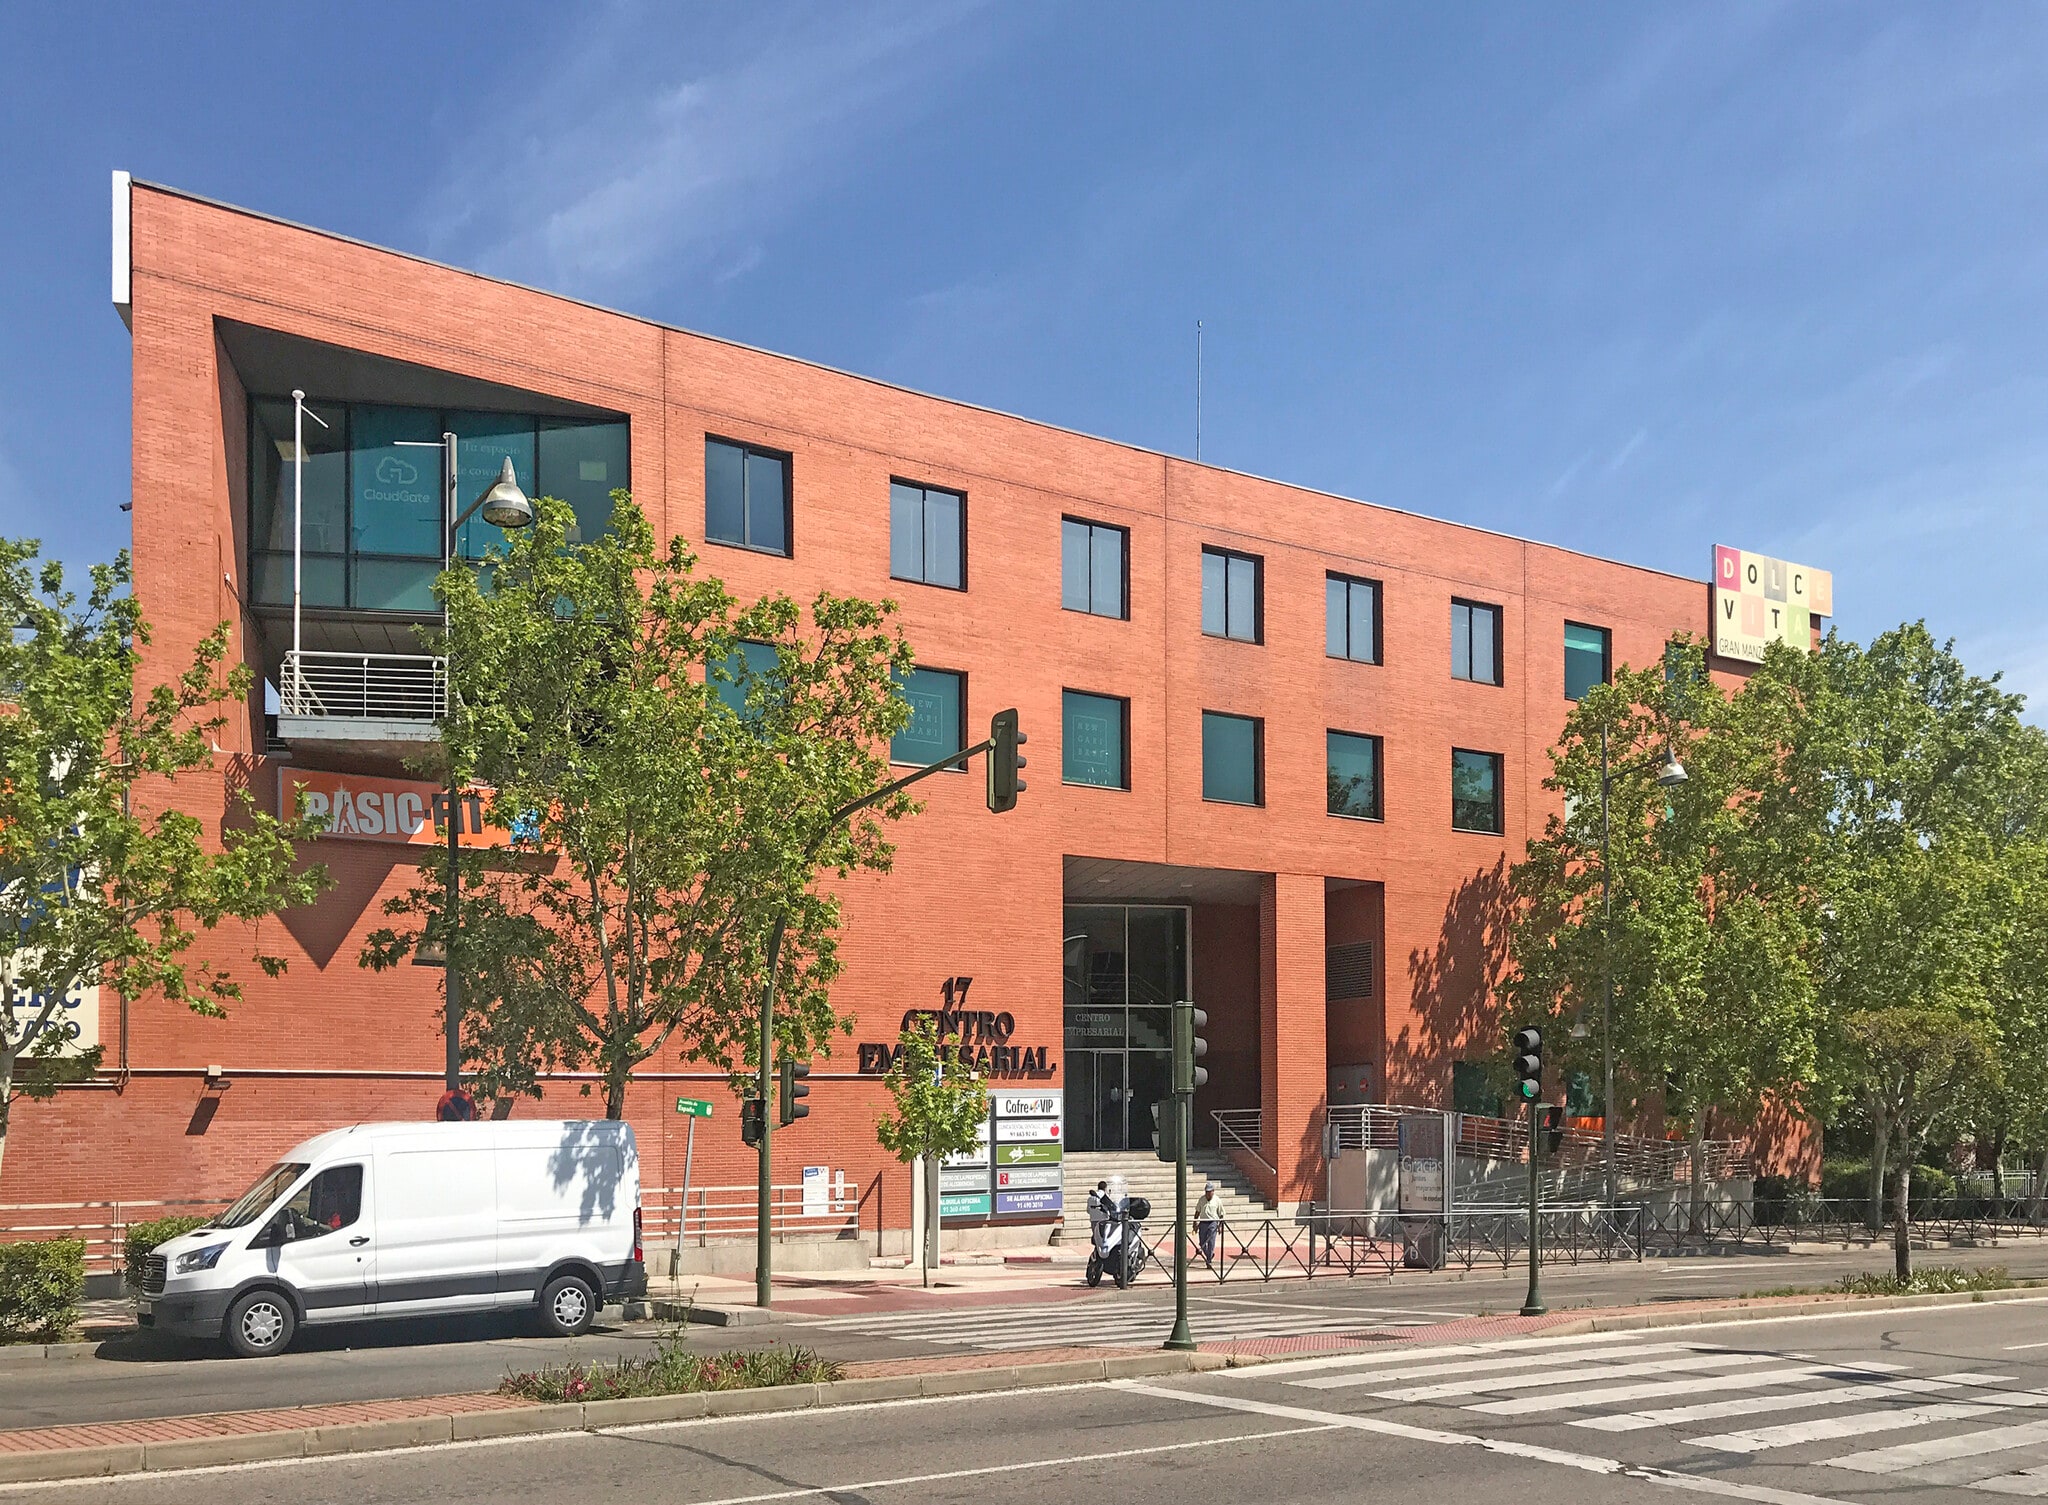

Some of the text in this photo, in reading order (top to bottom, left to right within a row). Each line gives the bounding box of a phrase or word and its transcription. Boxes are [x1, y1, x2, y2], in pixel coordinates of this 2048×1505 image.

[364, 488, 430, 503] CloudGate
[1723, 557, 1826, 602] DOLCE
[1724, 598, 1804, 636] VITA
[1719, 638, 1740, 654] GRAN
[940, 977, 973, 1006] 17
[1076, 1014, 1110, 1022] CENTRO
[1006, 1099, 1053, 1114] Cofre VIP
[1401, 1155, 1442, 1173] Gracias
